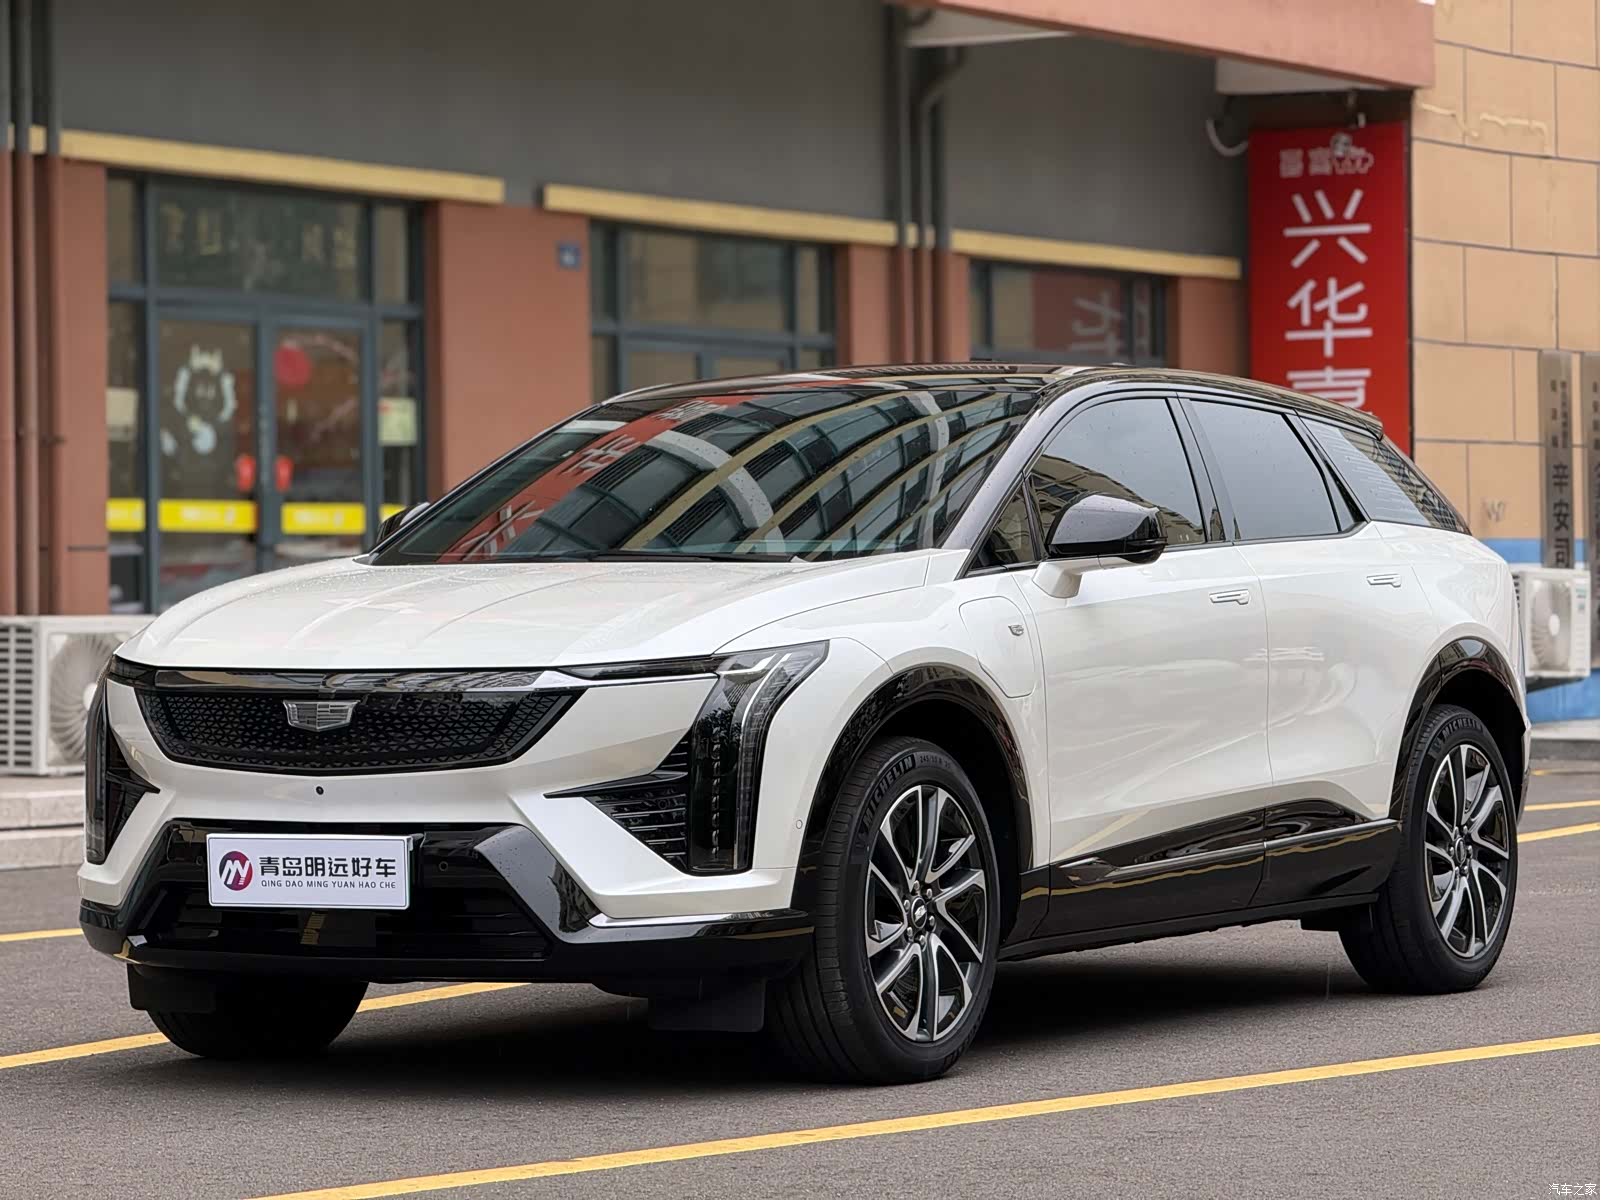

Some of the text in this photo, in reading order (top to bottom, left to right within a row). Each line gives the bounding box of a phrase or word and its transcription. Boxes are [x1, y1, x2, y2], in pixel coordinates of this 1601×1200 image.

[1442, 719, 1483, 739] MICHELIN
[862, 755, 914, 829] MICHELIN
[259, 856, 396, 878] 青岛明远好车
[261, 880, 396, 889] QING DAO MING YUAN HAO CHE
